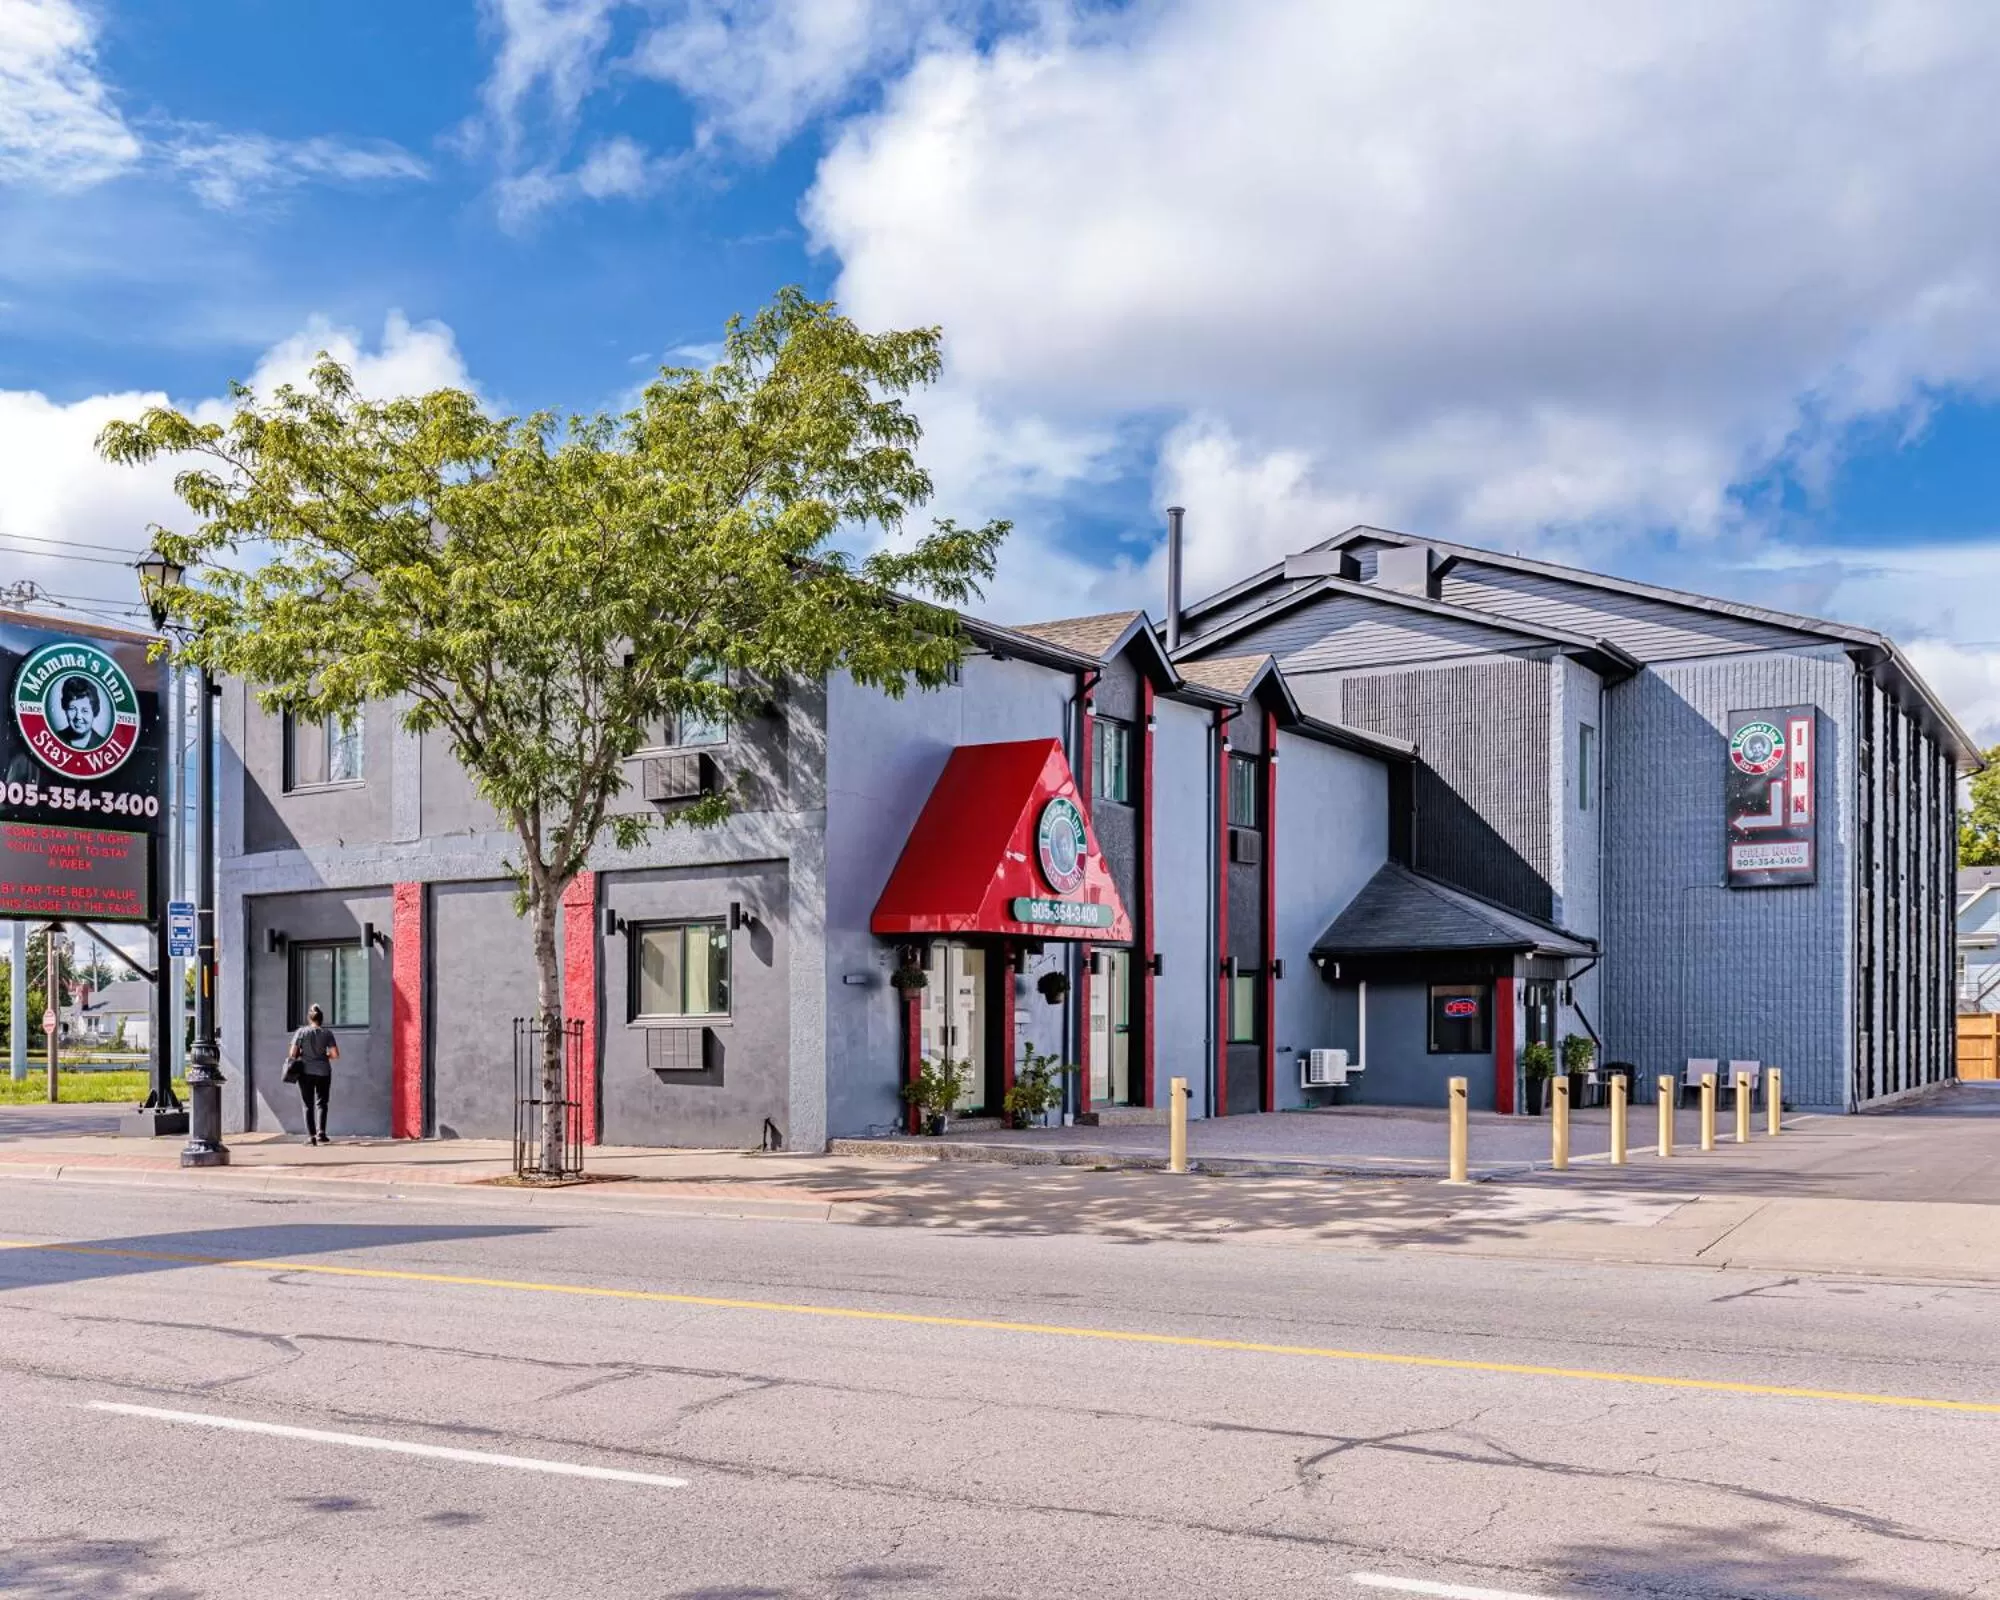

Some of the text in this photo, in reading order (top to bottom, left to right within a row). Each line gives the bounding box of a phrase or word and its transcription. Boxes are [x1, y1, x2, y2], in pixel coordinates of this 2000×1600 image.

[22, 652, 126, 703] Mamma's Inn
[20, 703, 136, 724] Since 2021
[33, 730, 126, 771] Stay Well
[1071, 814, 1082, 838] Inn
[41, 828, 68, 840] STAY
[73, 831, 94, 842] THE
[48, 844, 80, 856] WANT
[85, 845, 99, 857] TO
[101, 847, 128, 858] STAY
[60, 858, 92, 870] WEEK
[1, 883, 136, 900] BY FAR THE BEST VALUE
[67, 900, 81, 911] TO
[84, 901, 104, 913] THE
[1031, 902, 1098, 924] 905-354-3400
[1447, 1002, 1476, 1013] OPEN
